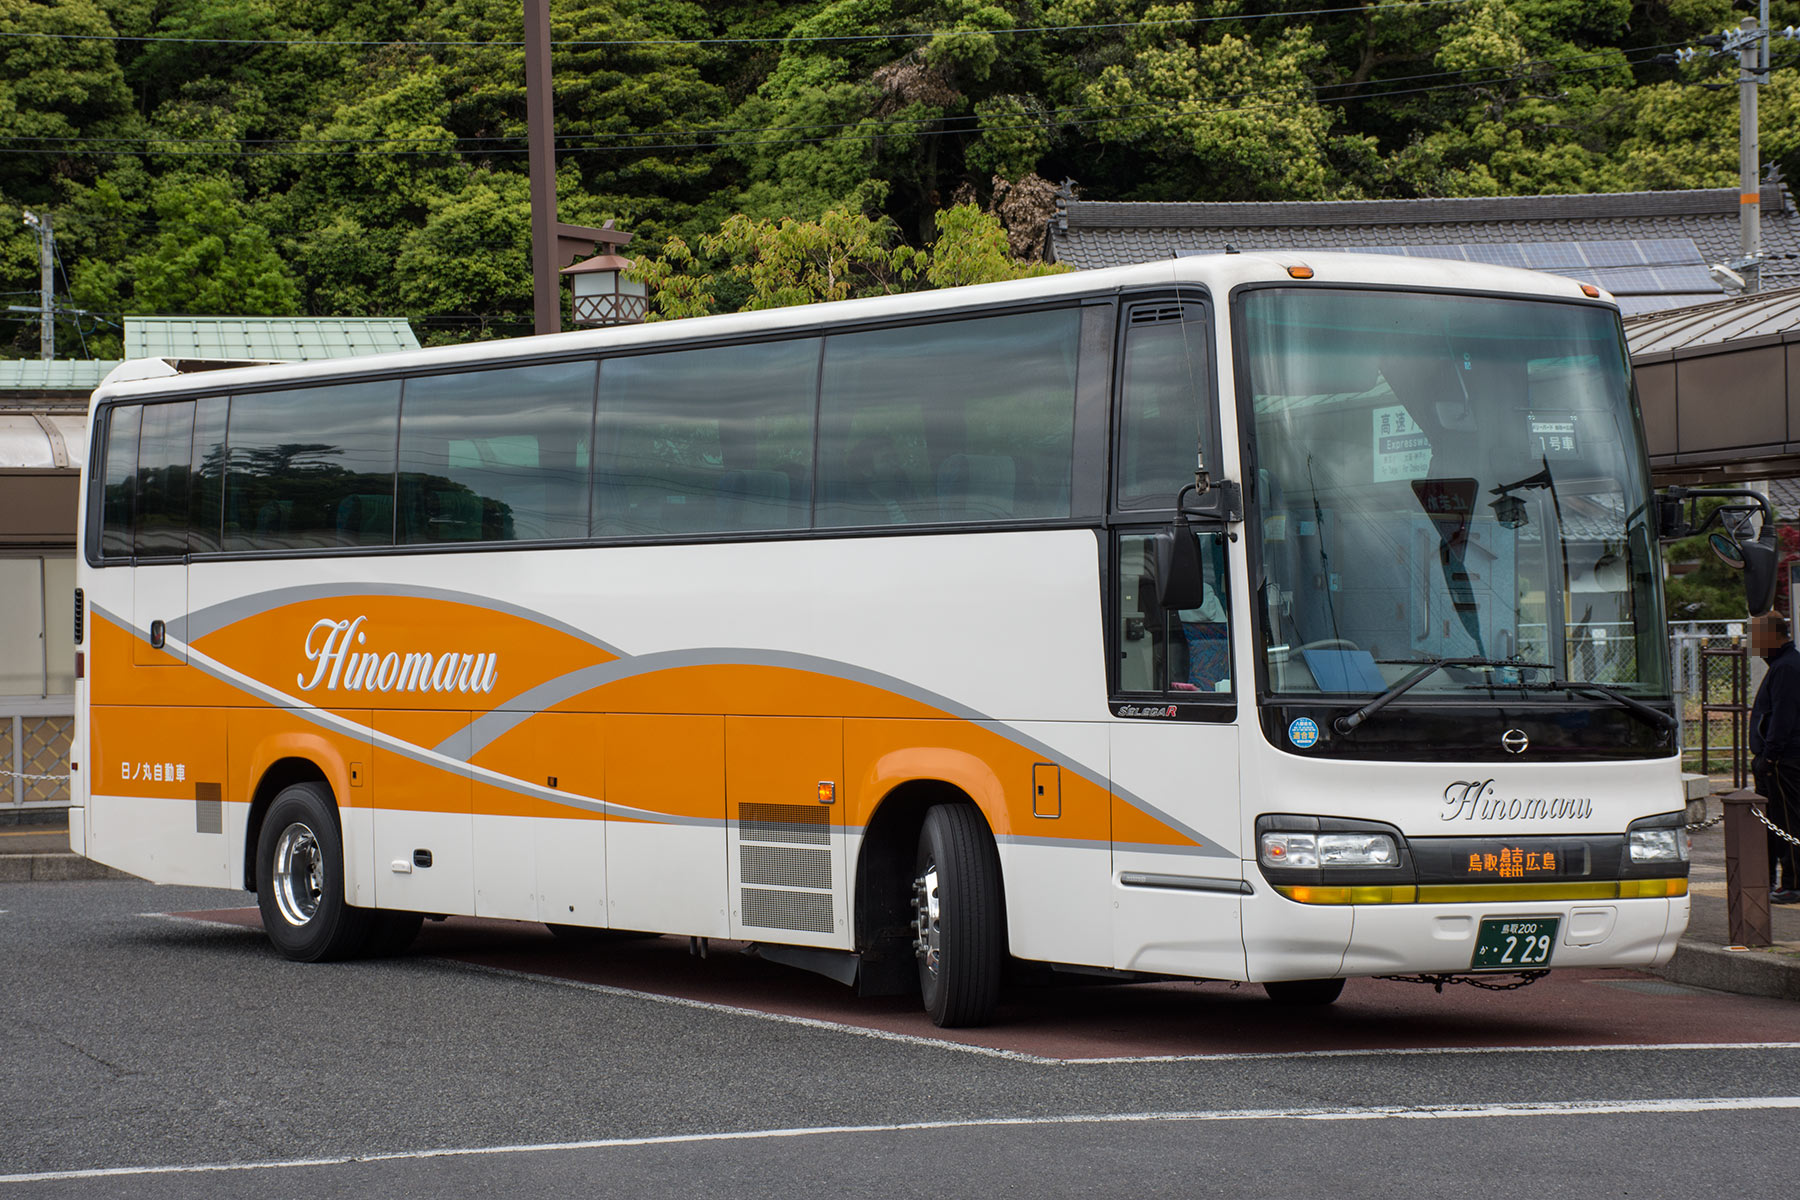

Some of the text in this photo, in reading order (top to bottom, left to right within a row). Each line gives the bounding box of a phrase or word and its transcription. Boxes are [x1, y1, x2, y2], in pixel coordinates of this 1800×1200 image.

[1386, 437, 1430, 450] Expresswa
[1539, 436, 1575, 451] 1号車
[297, 615, 498, 693] Hinomaru
[121, 761, 186, 782] 日ノ丸自動車
[1441, 778, 1592, 821] Hinomaru
[1468, 853, 1498, 872] 鳥取
[1500, 847, 1524, 863] 倉吉
[1526, 852, 1556, 871] 広島
